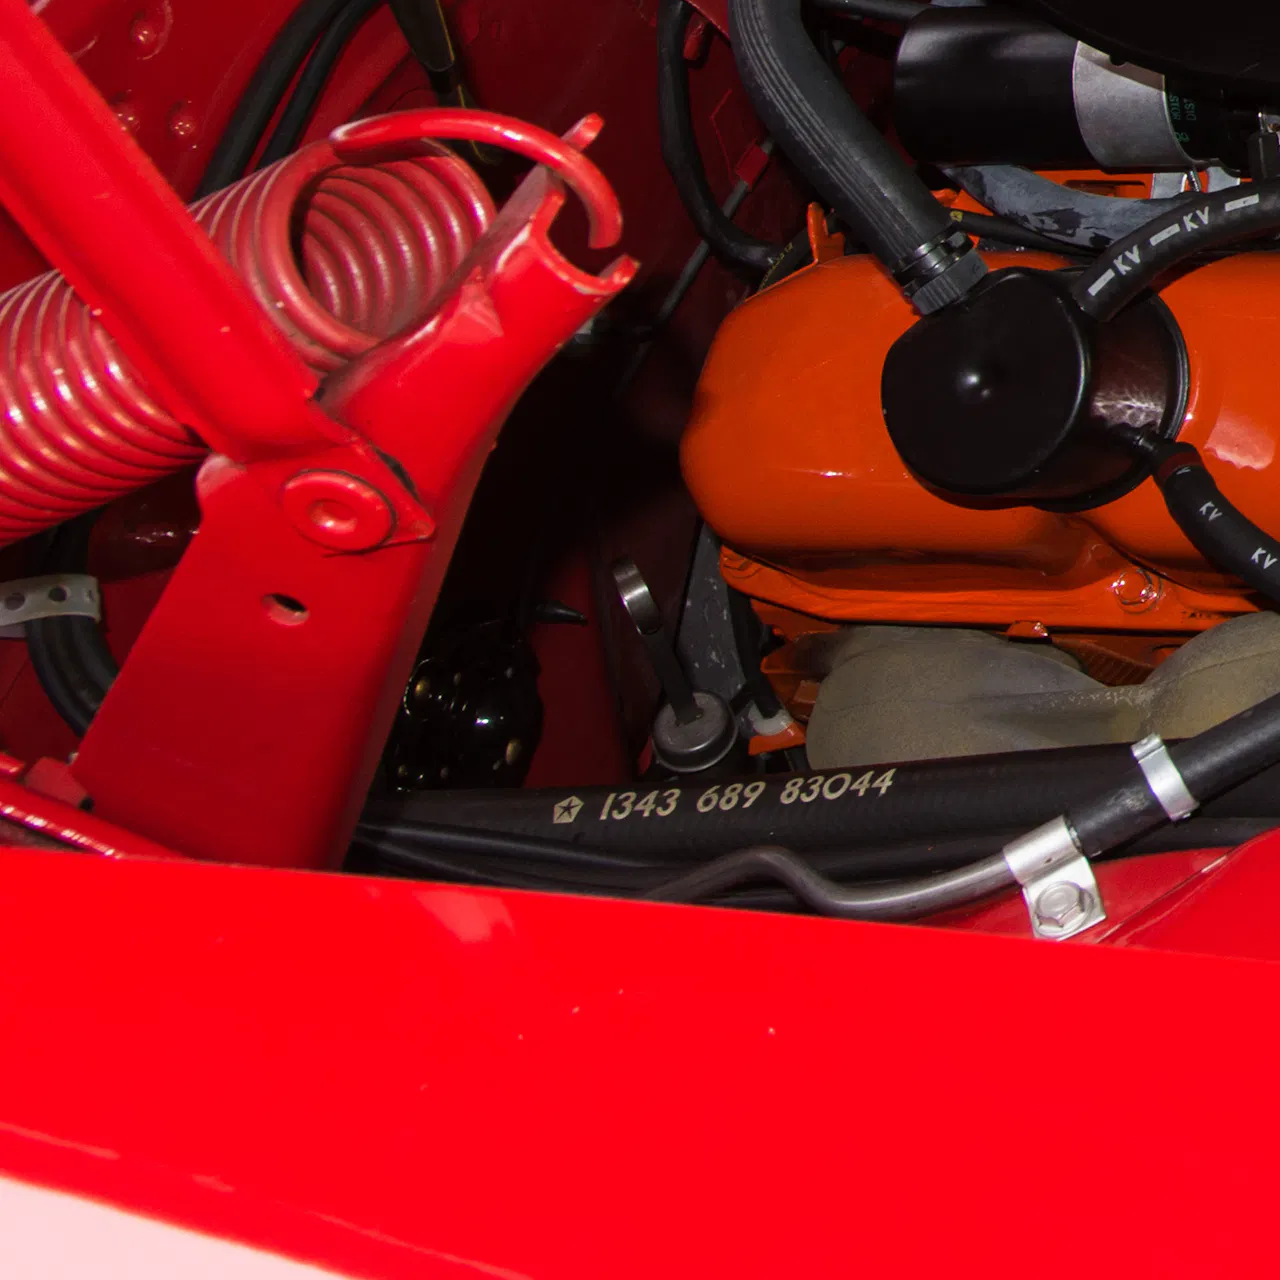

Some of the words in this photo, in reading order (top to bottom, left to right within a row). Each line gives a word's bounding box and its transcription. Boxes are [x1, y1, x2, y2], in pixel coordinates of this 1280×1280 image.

[1111, 243, 1144, 277] KV
[1181, 205, 1213, 234] KV
[1199, 500, 1222, 522] KV
[1251, 546, 1278, 570] KV
[599, 788, 681, 821] 1343
[696, 781, 767, 813] 689
[779, 768, 898, 805] 83044
